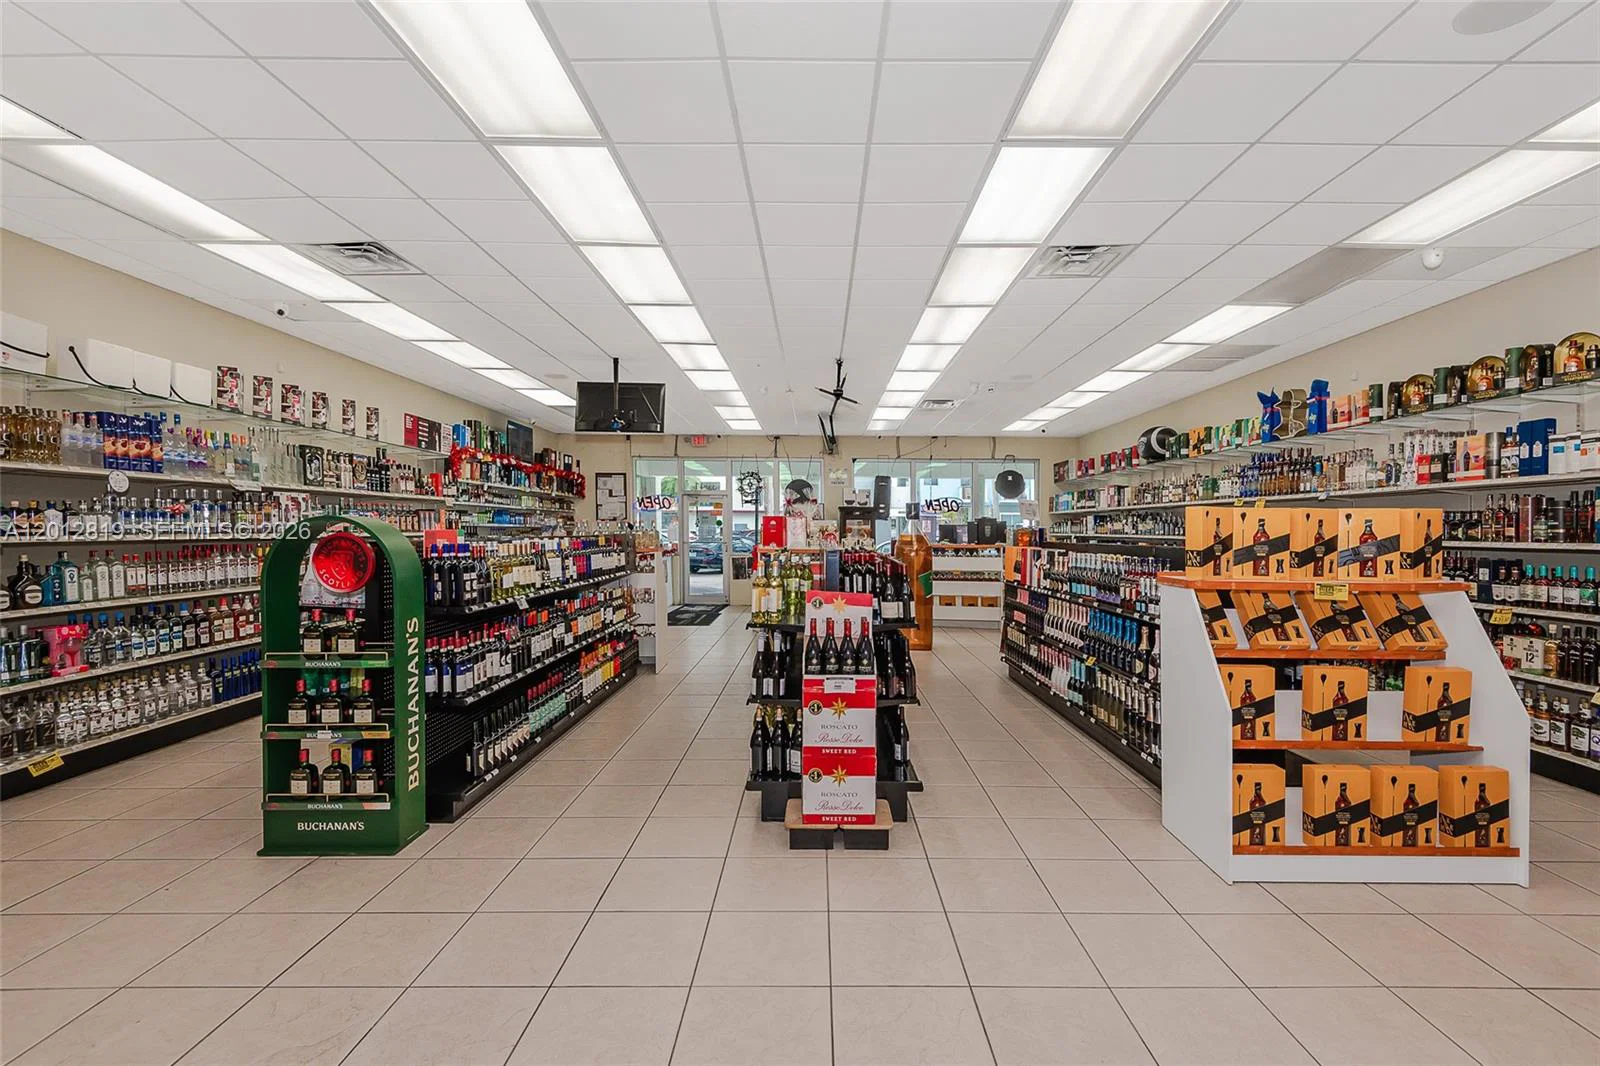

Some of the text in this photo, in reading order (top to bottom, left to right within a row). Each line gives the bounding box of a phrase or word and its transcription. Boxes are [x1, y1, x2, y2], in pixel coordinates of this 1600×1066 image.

[1525, 652, 1535, 663] 12
[304, 660, 341, 668] BUCHANAN'S
[407, 617, 420, 792] BUCHANAN'S
[297, 821, 365, 831] BUCHANAN'S
